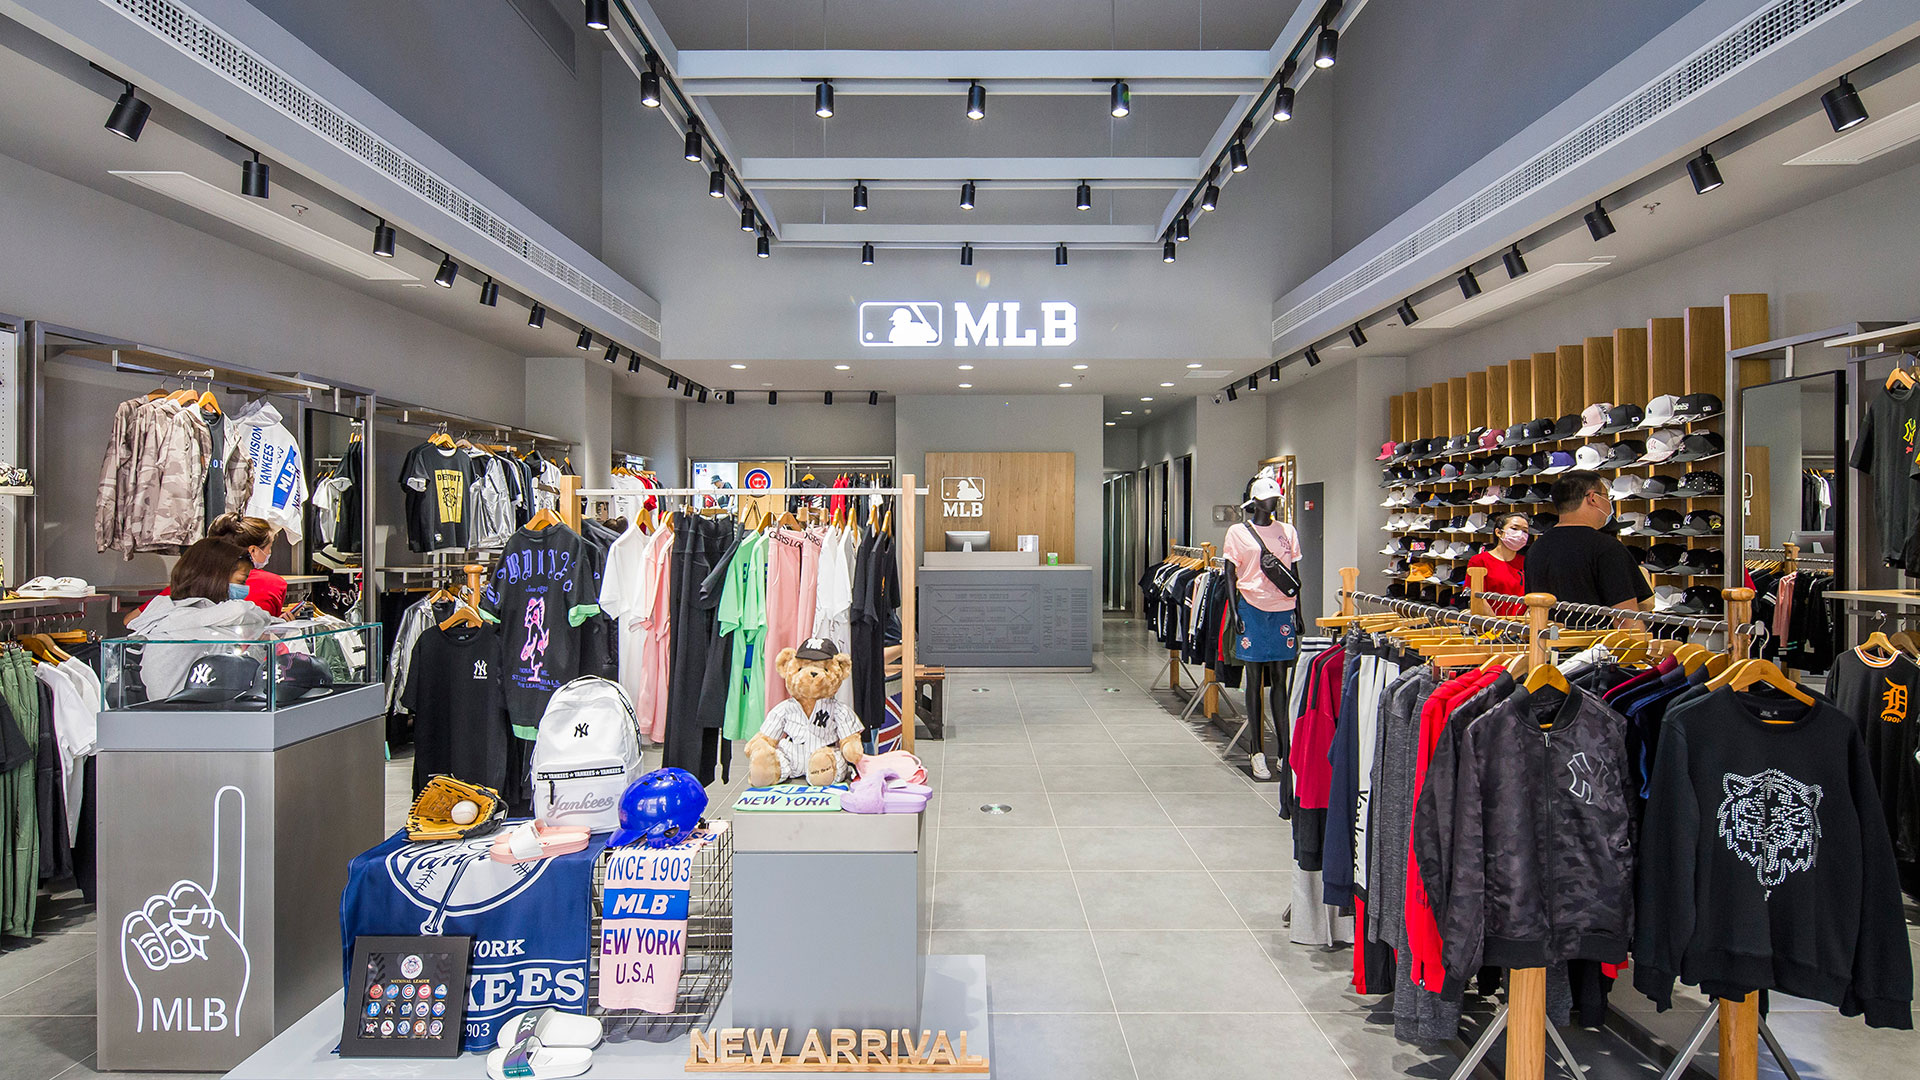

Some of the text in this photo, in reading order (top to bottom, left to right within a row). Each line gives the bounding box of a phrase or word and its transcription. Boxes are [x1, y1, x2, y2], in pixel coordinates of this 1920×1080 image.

[954, 302, 1077, 347] MLB
[249, 424, 263, 468] IVISION
[259, 443, 275, 486] YANKEES
[277, 462, 296, 493] MLB
[943, 502, 983, 517] MLB
[473, 660, 488, 676] NY
[574, 722, 590, 738] NY
[544, 792, 616, 819] Yankees
[738, 795, 832, 807] NEW YORK
[651, 856, 692, 882] 1903
[612, 893, 669, 915] MLB
[636, 927, 682, 956] YORK
[616, 961, 655, 984] U.S.A
[152, 997, 229, 1032] MLB
[465, 1022, 491, 1038] 903
[689, 1028, 984, 1065] NEW ARRIVAL
